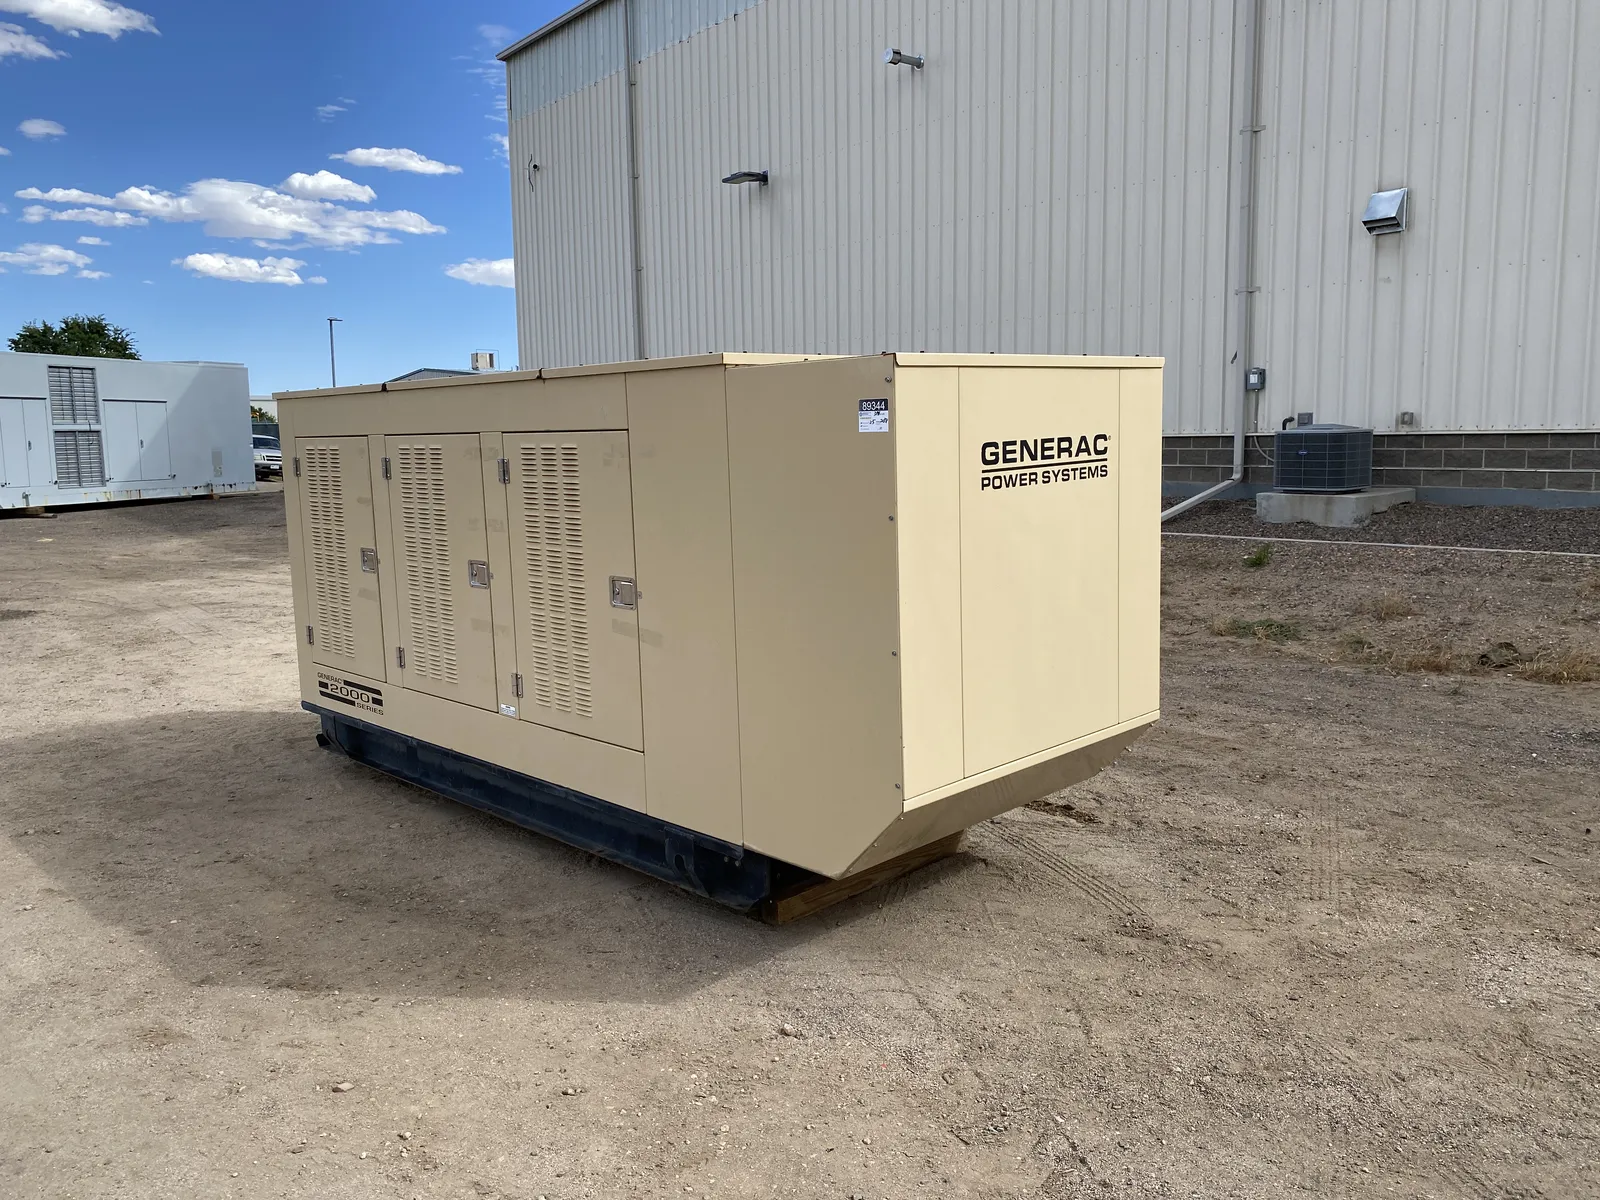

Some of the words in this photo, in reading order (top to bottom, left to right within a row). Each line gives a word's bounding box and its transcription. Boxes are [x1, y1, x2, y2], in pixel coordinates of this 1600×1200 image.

[862, 401, 885, 411] 89344
[981, 433, 1108, 466] GENERAC
[981, 471, 1038, 491] POWER
[1041, 464, 1108, 484] SYSTEMS
[317, 672, 343, 684] GENERAC
[330, 683, 370, 703] 2000
[356, 702, 384, 716] SERIES
